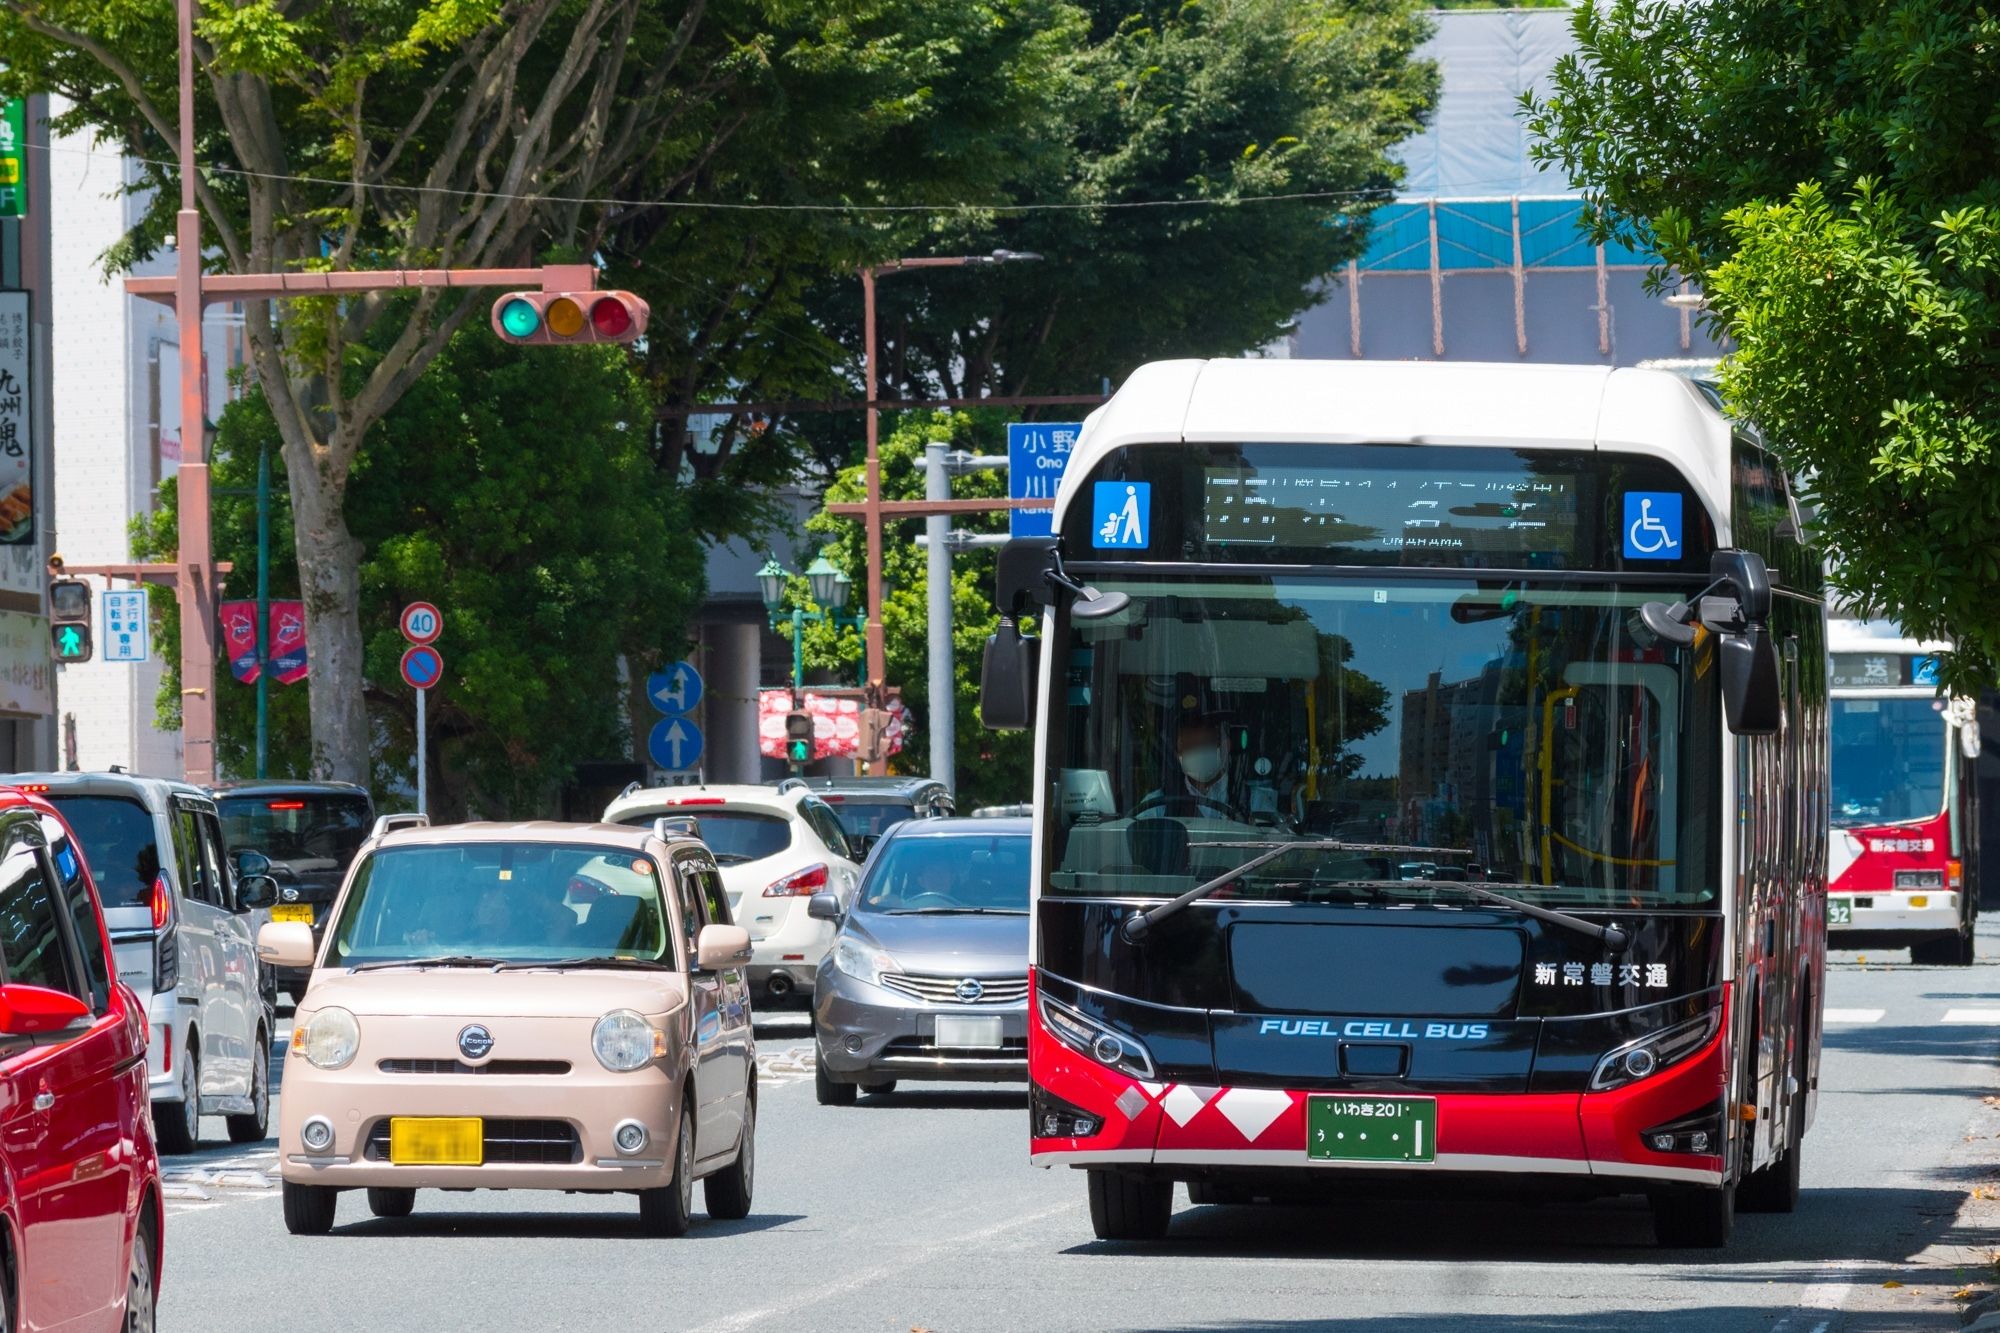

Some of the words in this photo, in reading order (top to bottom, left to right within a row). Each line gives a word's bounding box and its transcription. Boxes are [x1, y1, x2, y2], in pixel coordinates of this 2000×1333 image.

[1036, 456, 1063, 469] Ono
[411, 614, 433, 633] 40
[1834, 676, 1846, 685] OF
[1852, 676, 1888, 685] SERVICE
[1534, 961, 1669, 987] 新常磐交通
[1260, 1020, 1338, 1036] FUEL
[1343, 1022, 1418, 1038] CELL
[1424, 1023, 1489, 1039] BUS
